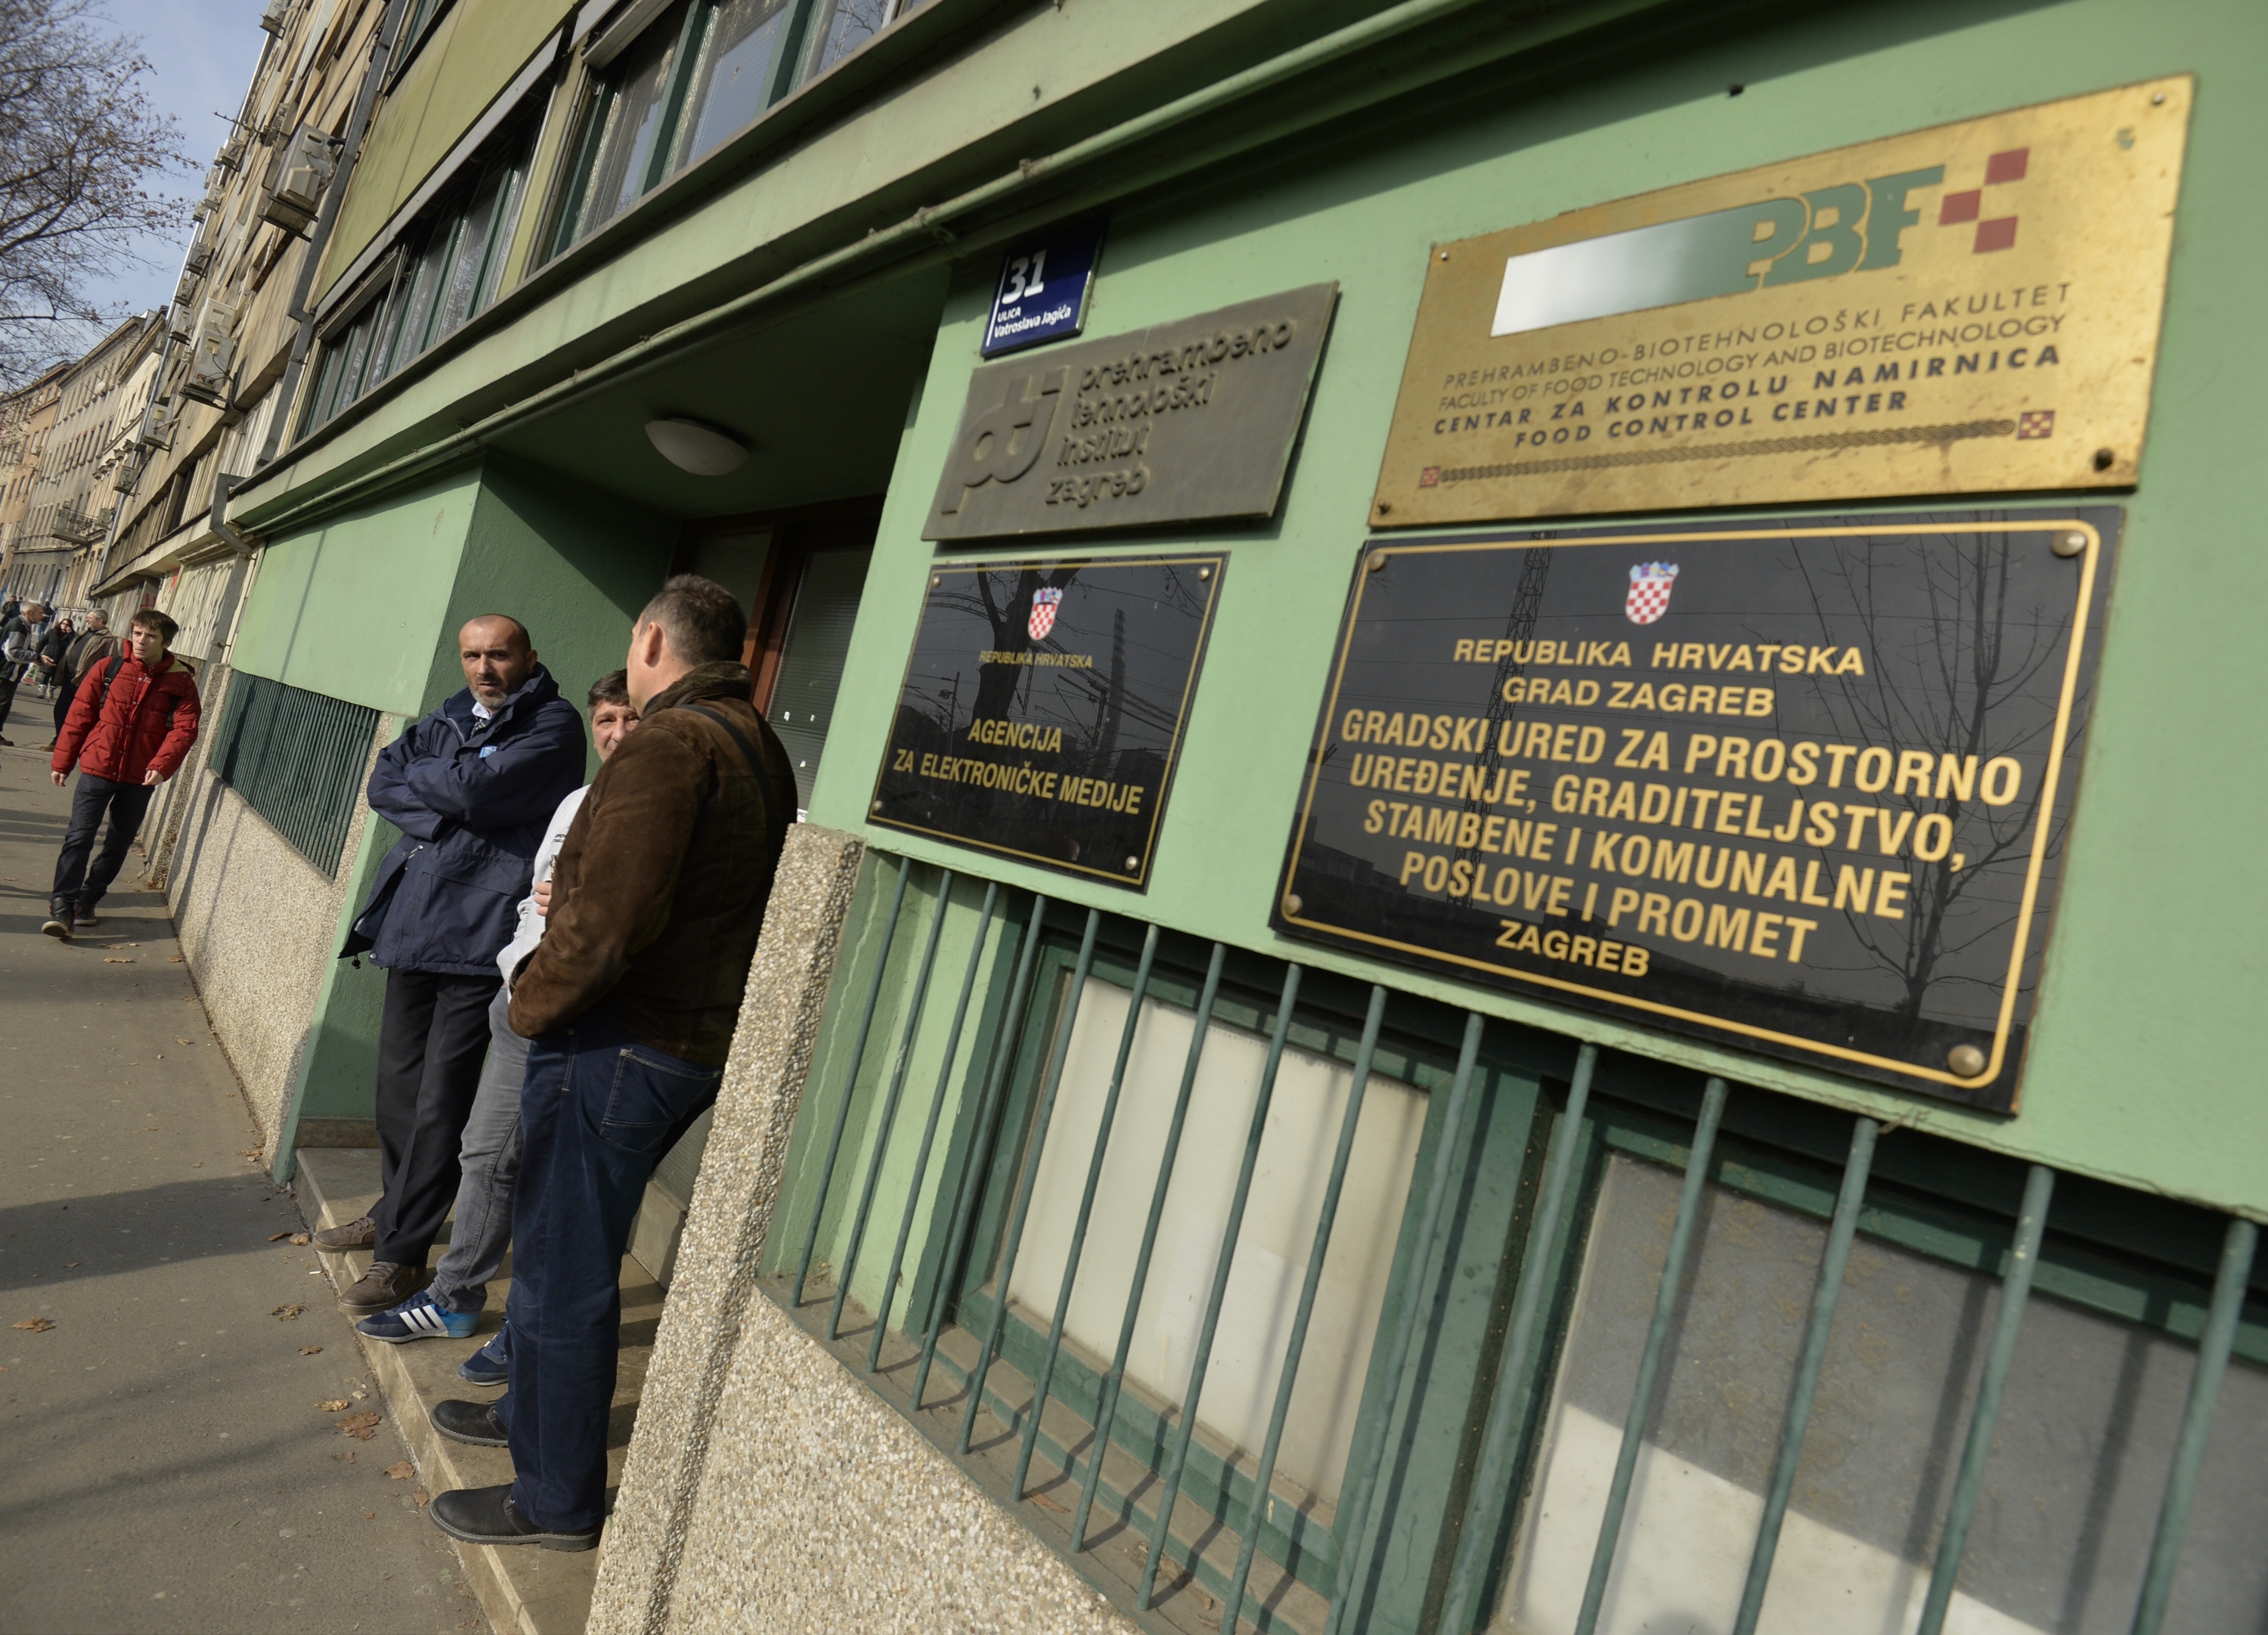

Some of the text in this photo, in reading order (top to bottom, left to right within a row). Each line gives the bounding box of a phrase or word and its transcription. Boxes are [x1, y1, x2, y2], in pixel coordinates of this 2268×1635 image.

[1745, 165, 1946, 289] PBF
[1002, 249, 1047, 305] 31
[994, 303, 1072, 339] Vatroslava Jagića
[997, 306, 1021, 323] ULICA
[1443, 283, 2071, 390] PREHRAMBENO-BIOTEHNOLOŠKI FAKULTET
[1077, 320, 1296, 398] prehrambeno
[1439, 314, 2065, 411] FACULTY OF FOOD TECHNOLOGY AND BIOTECHNOLOGY
[1071, 370, 1218, 429] tehnološki
[1434, 345, 2060, 435] CENTAR ZA KONTROLU NAMIRNICA
[1514, 391, 1907, 448] FOOD CONTROL CENTER
[1058, 423, 1152, 466] institut
[1046, 462, 1151, 509] zagreb
[978, 650, 1093, 669] REPUBLIKA HRVATSKA
[1453, 638, 1866, 677] REPUBLIKA HRVATSKA
[1501, 677, 1776, 717] GRAD ZAGREB
[967, 717, 1063, 754] AGENCIJA
[1340, 708, 2022, 807] GRADSKI URED ZA PROSTORNO
[893, 748, 1145, 816] ZA ELEKTRONIČKE MEDIJE
[1349, 752, 1966, 873] UREĐENJE, GRADITELJSTVO,
[1363, 798, 1912, 920] STAMBENE I KOMUNALNE
[1399, 850, 1819, 965] POSLOVE I PROMET
[1495, 918, 1651, 978] ZAGREB
